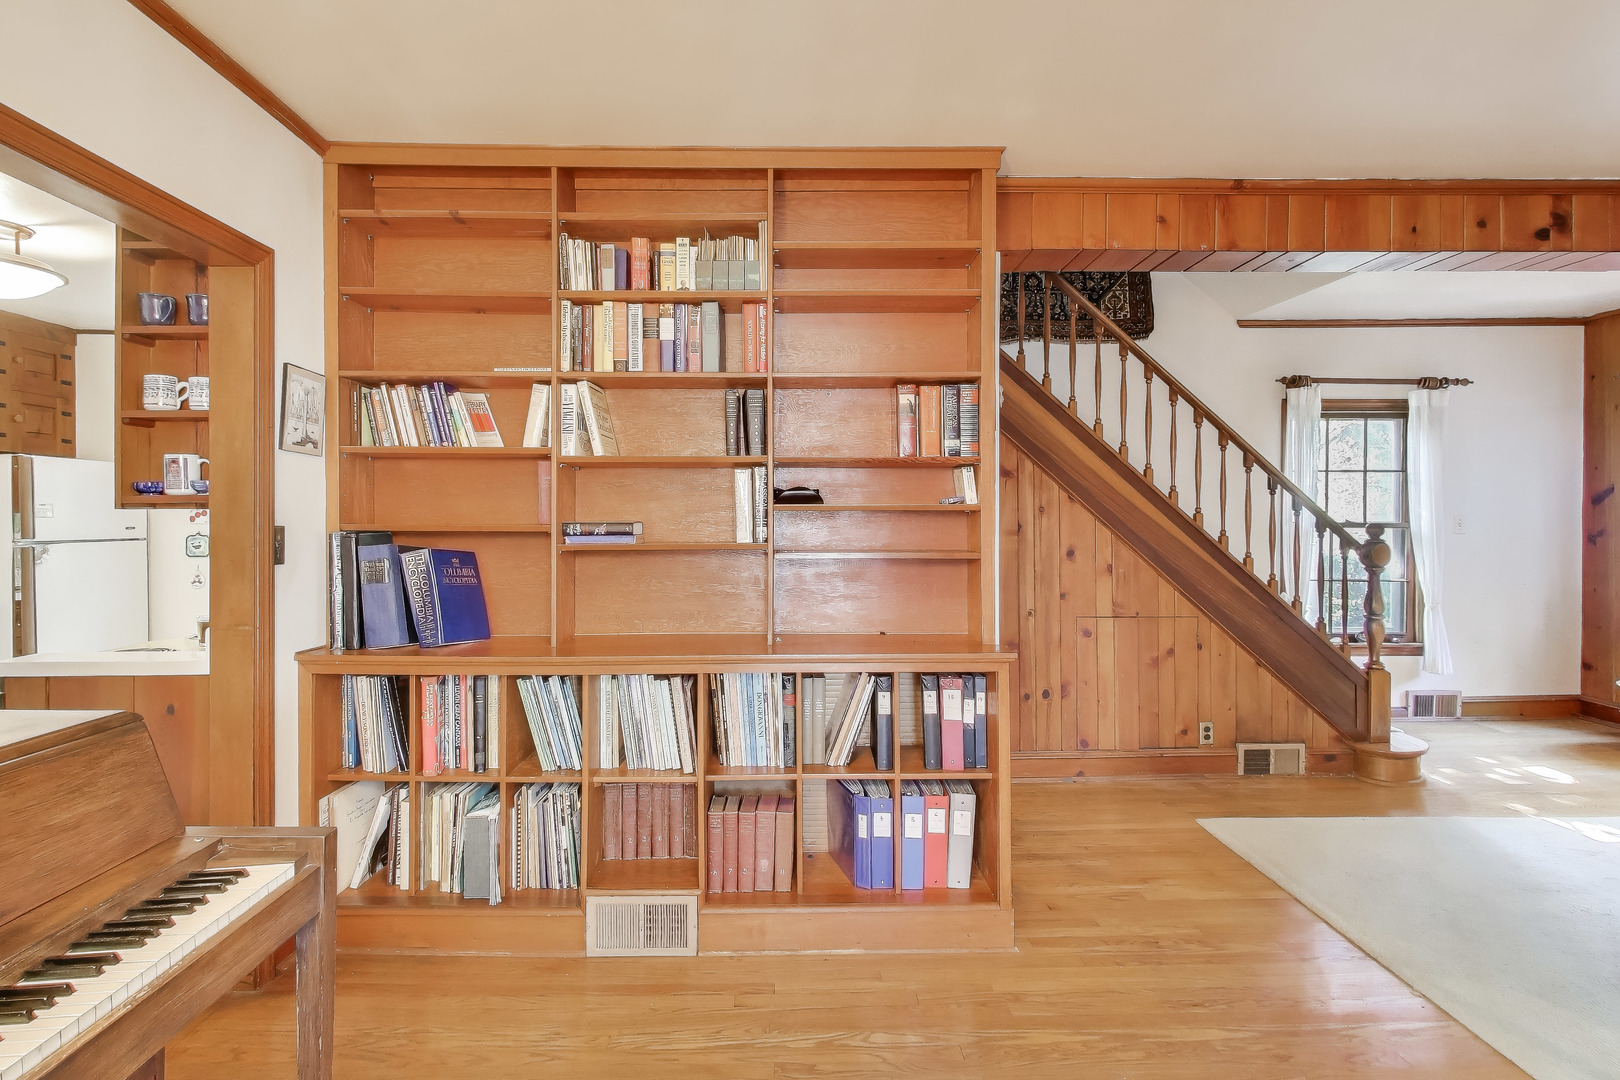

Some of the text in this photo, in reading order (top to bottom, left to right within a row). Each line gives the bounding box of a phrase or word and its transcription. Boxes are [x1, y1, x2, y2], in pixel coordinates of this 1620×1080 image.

[562, 402, 574, 435] YINGLISH
[406, 555, 426, 625] ENCYCLOPEDIA
[415, 553, 433, 623] THE COLUMBIA
[756, 707, 765, 738] GIOVANNI
[641, 835, 647, 843] 3
